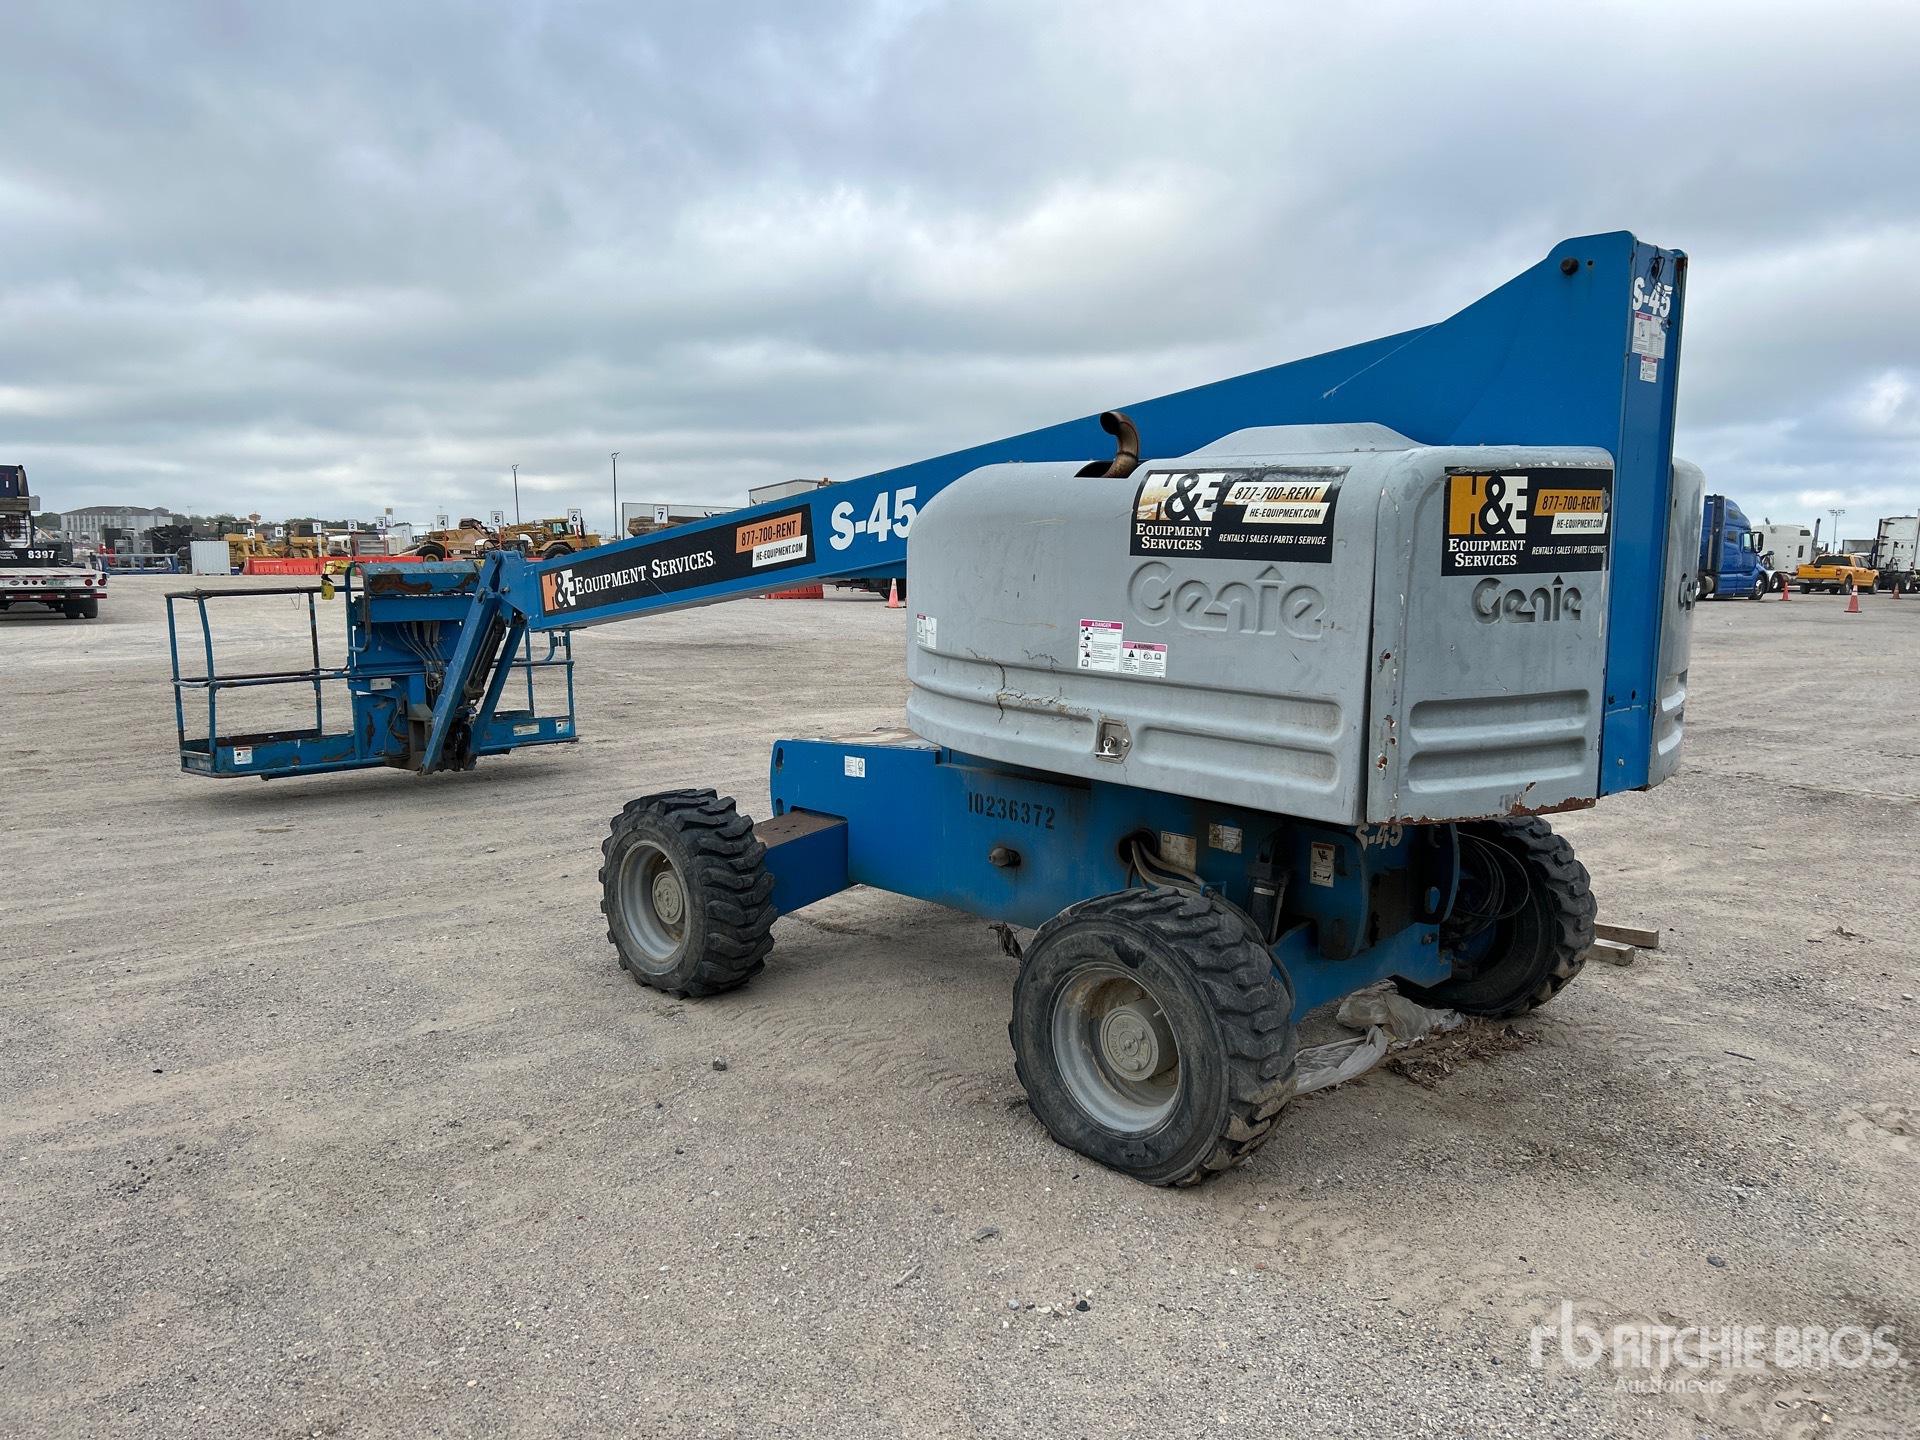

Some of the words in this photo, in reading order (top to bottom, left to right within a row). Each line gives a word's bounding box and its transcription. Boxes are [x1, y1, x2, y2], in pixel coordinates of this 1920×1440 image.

[1632, 276, 1673, 318] S-45
[1137, 472, 1226, 522] H&E
[1234, 486, 1321, 501] 877-700-RENT
[1448, 475, 1529, 535] H&E
[1541, 495, 1601, 511] 877-700-RENT
[571, 514, 578, 522] 6
[658, 511, 664, 520] 7
[829, 485, 918, 551] S-45
[1249, 507, 1321, 519] HE-EQUIPMENT.COM
[1556, 518, 1604, 529] HE-EQUIPMENT.COM
[740, 520, 797, 547] 877-700-RENT
[1218, 533, 1245, 543] RENTALS
[1249, 534, 1268, 544] SALES
[1273, 535, 1293, 544] PARTS
[1298, 535, 1326, 546] SERVICE
[27, 550, 55, 559] 8397
[755, 542, 804, 562] HE-EQUIPMENT.COM
[1532, 546, 1554, 555] RENTALS
[1556, 546, 1570, 554] SALES
[1574, 546, 1588, 554] PARTS
[542, 569, 576, 611] H&E
[1471, 575, 1583, 624] Genie
